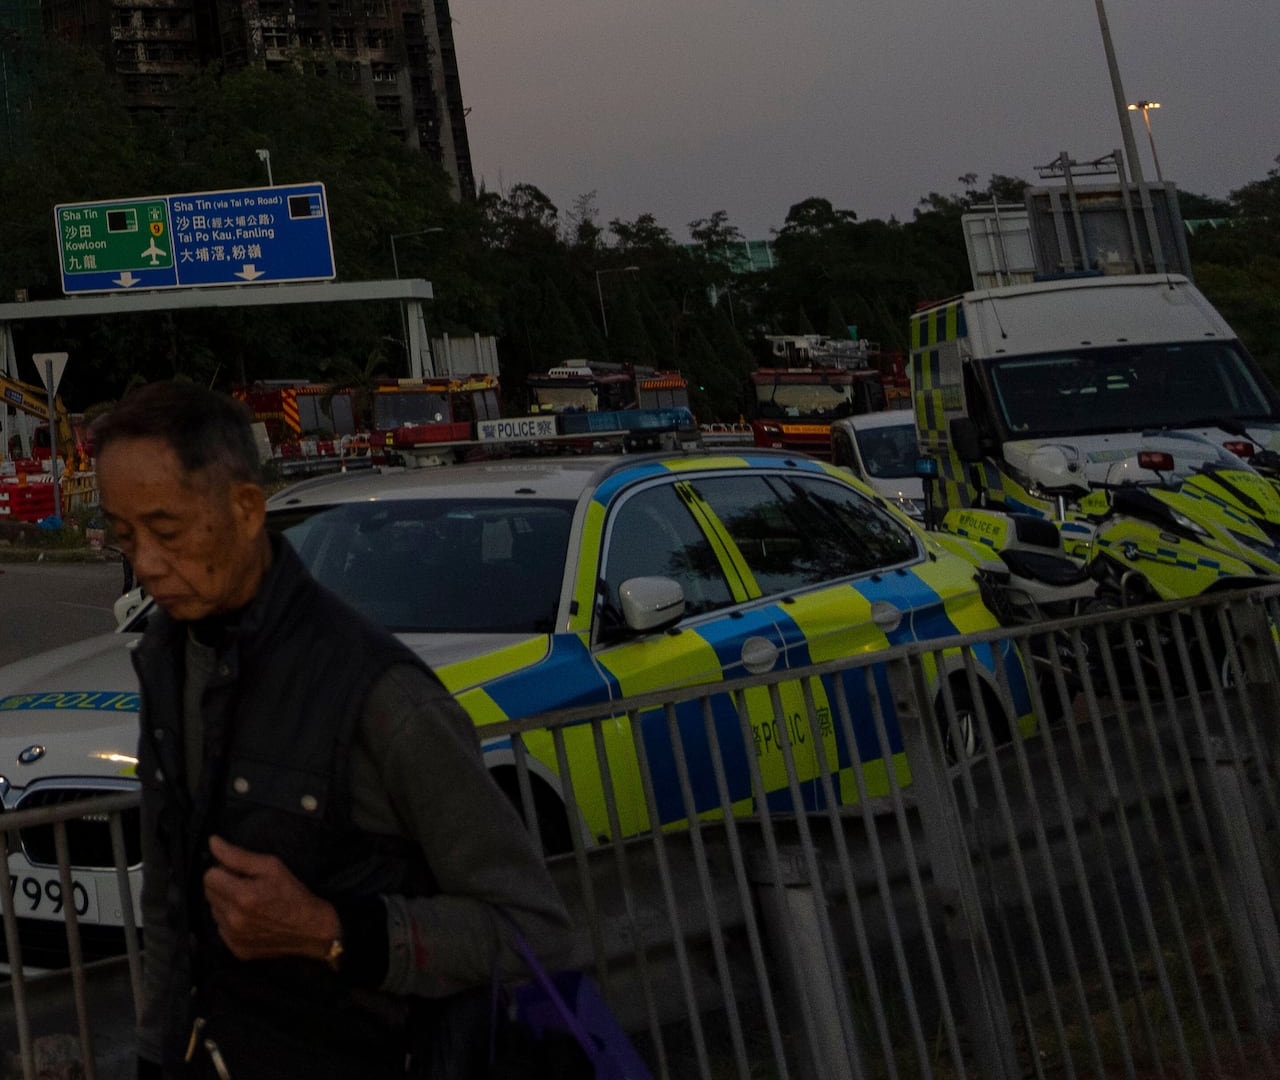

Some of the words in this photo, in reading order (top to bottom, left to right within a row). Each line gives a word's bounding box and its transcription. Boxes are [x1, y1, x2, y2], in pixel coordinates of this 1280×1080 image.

[174, 201, 193, 212] Sha
[195, 199, 211, 210] Tin
[213, 201, 228, 210] (via
[230, 199, 242, 207] Tai
[244, 198, 254, 206] Po
[63, 210, 80, 221] Sha
[83, 209, 98, 219] Tin
[65, 225, 92, 239] 沙田
[153, 224, 160, 234] 9
[178, 232, 192, 243] Tai
[196, 232, 209, 242] Po
[65, 240, 107, 251] Kowloon
[69, 254, 97, 270] 九龍
[498, 421, 535, 438] POLICE
[964, 515, 992, 533] POLICE
[30, 693, 140, 711] POLIC
